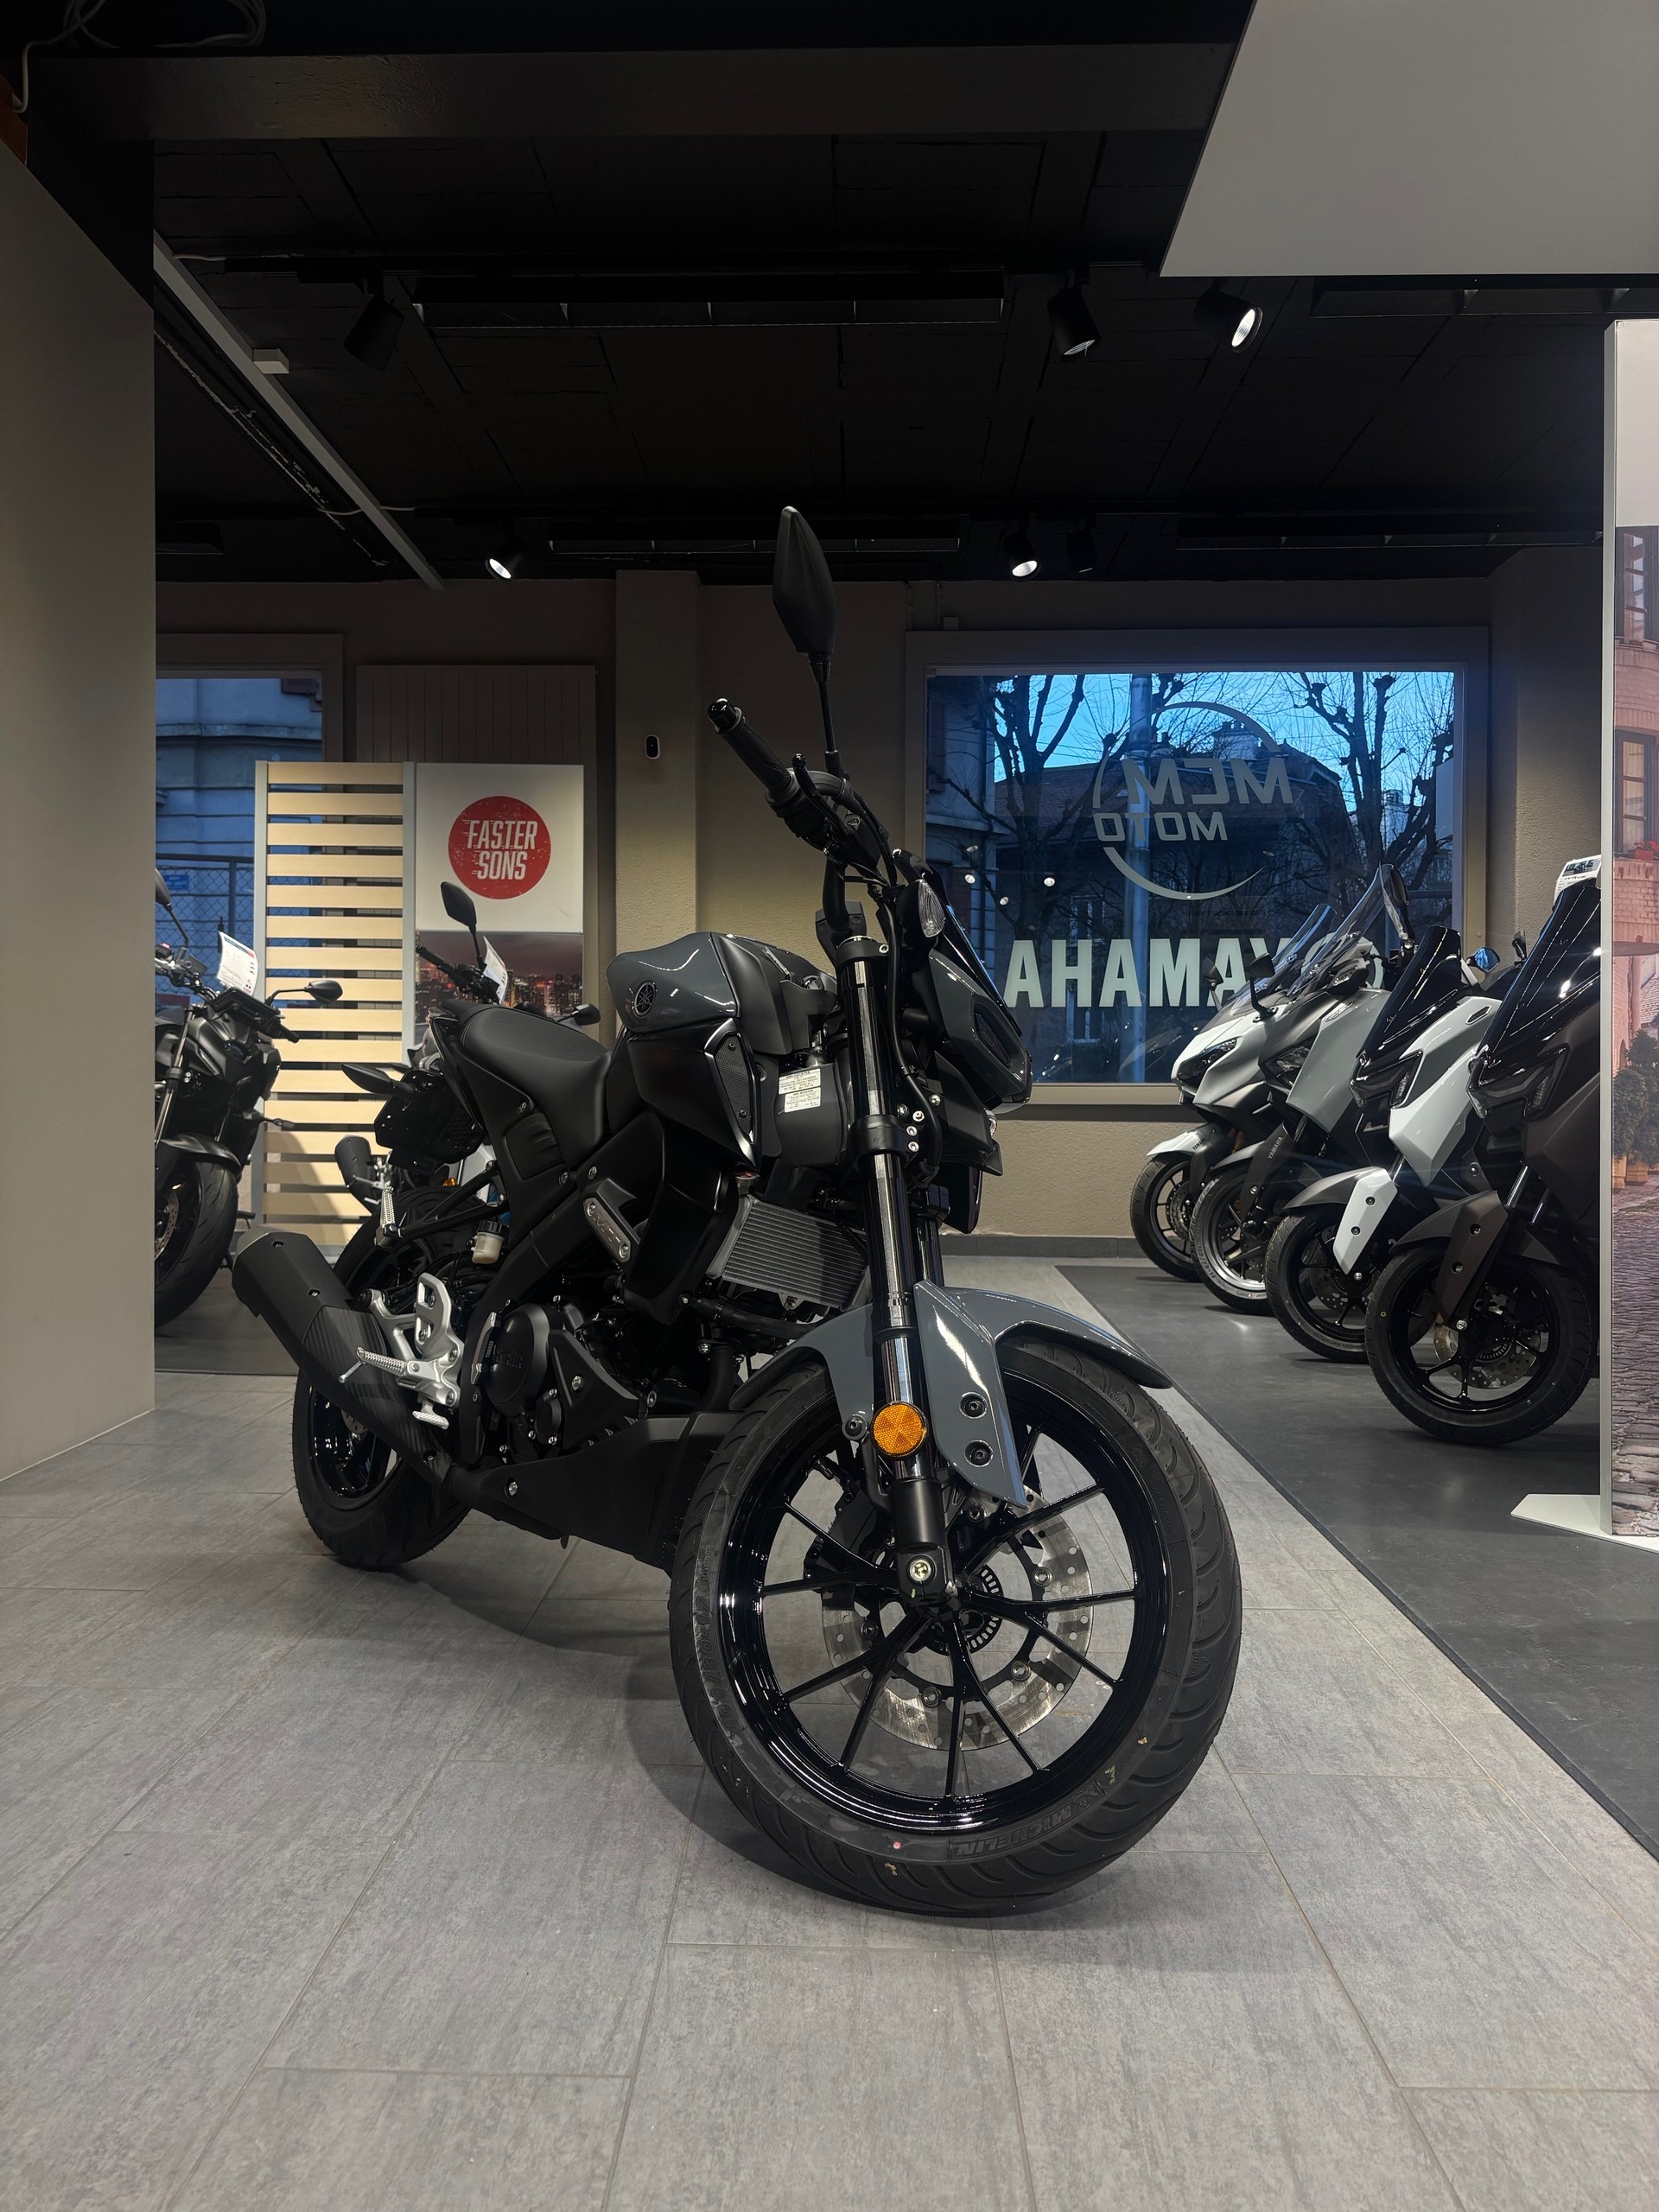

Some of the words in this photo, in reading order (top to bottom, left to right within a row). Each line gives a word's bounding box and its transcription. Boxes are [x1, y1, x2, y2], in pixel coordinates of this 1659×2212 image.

[467, 820, 538, 850] FASTER
[476, 850, 528, 880] SONS
[1267, 1136, 1284, 1160] YAMAHA
[592, 1211, 621, 1243] MT
[955, 1804, 1072, 1856] MICHELIN
